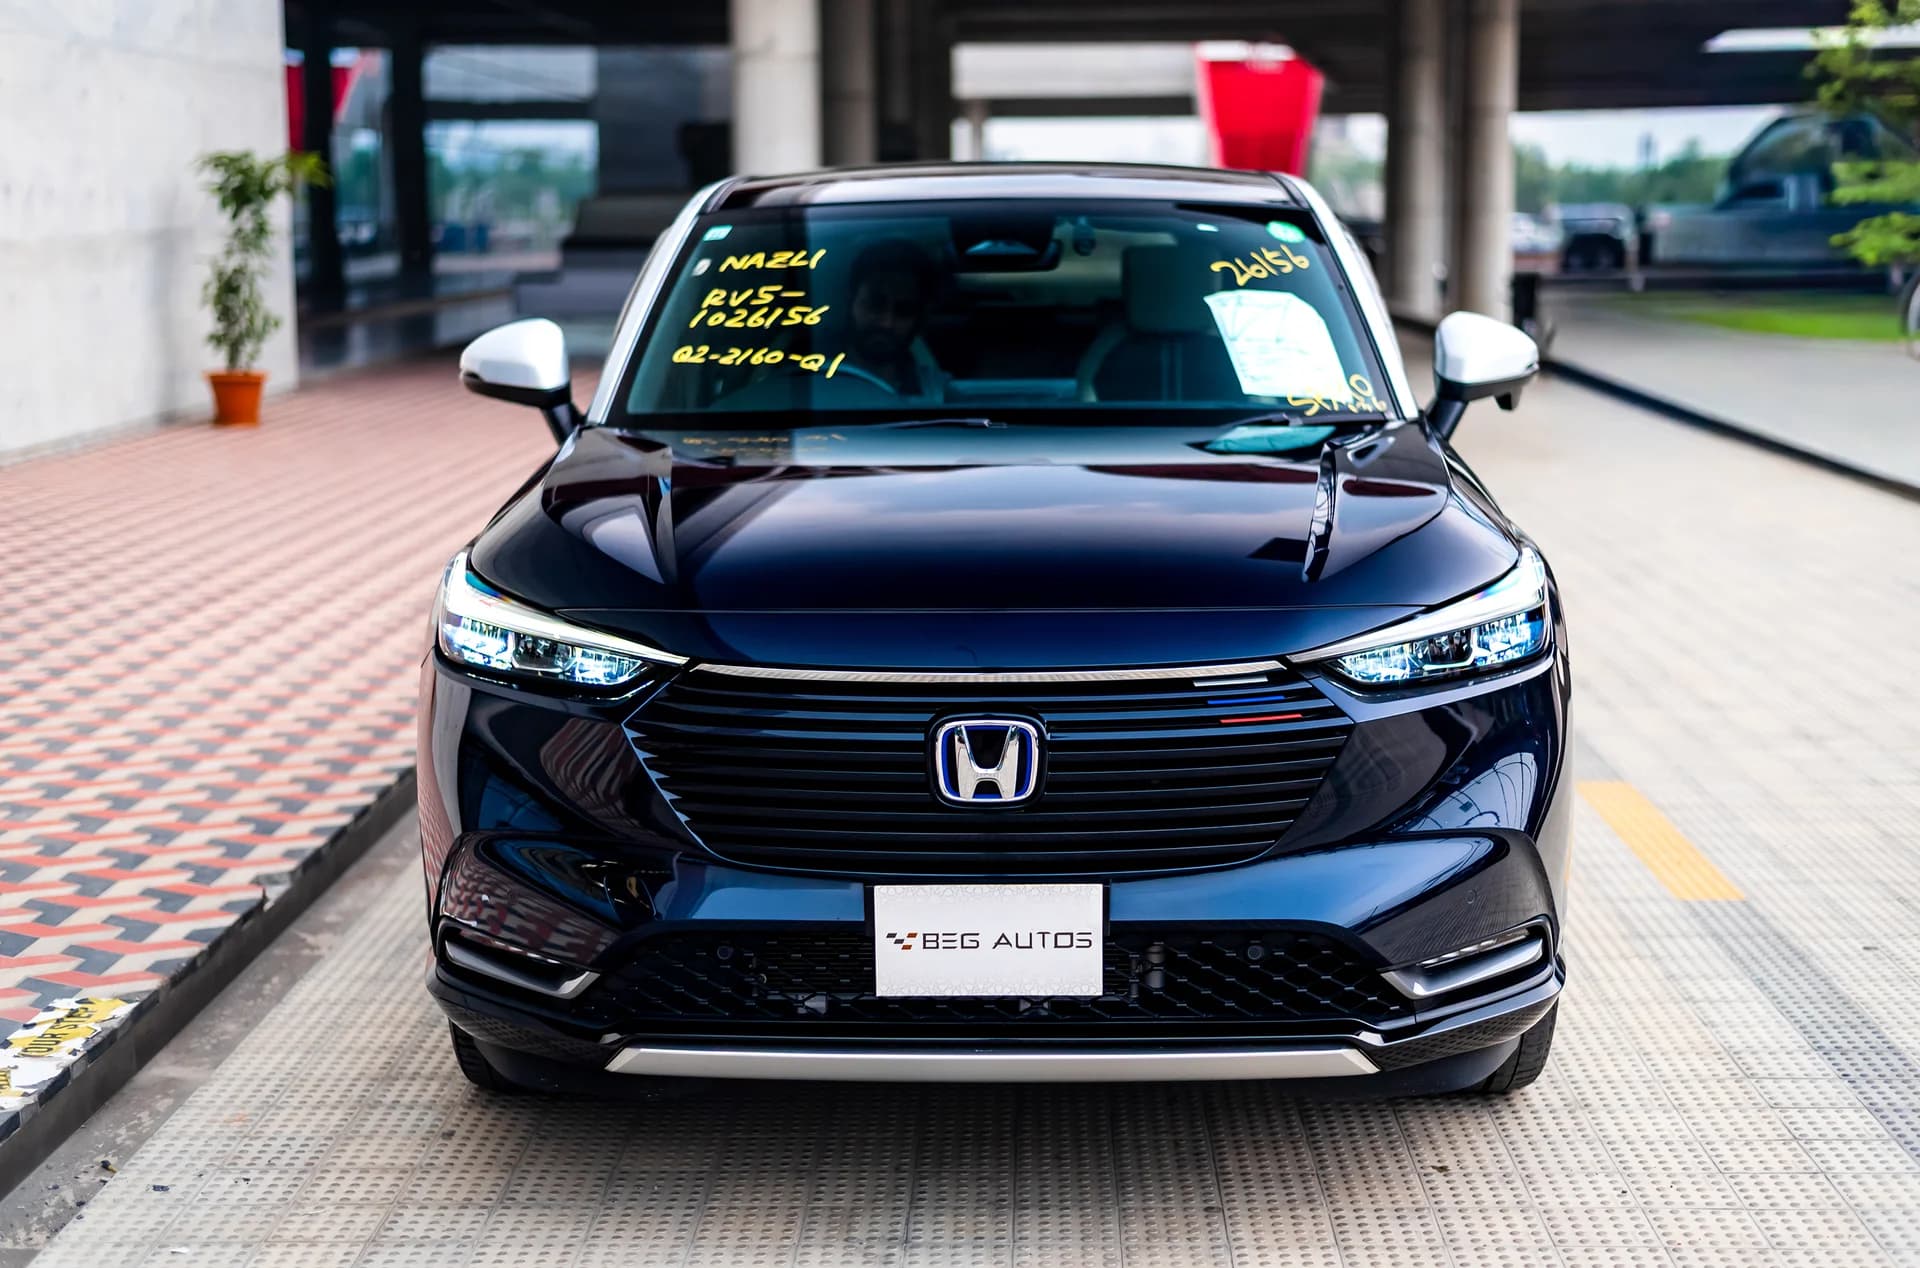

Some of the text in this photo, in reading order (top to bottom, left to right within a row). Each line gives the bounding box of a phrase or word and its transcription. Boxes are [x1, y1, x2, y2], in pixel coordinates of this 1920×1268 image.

[719, 249, 826, 272] NAZLI
[1210, 244, 1309, 286] 26156
[688, 305, 829, 329] 1026156
[922, 931, 1093, 950] BEG AUTOS
